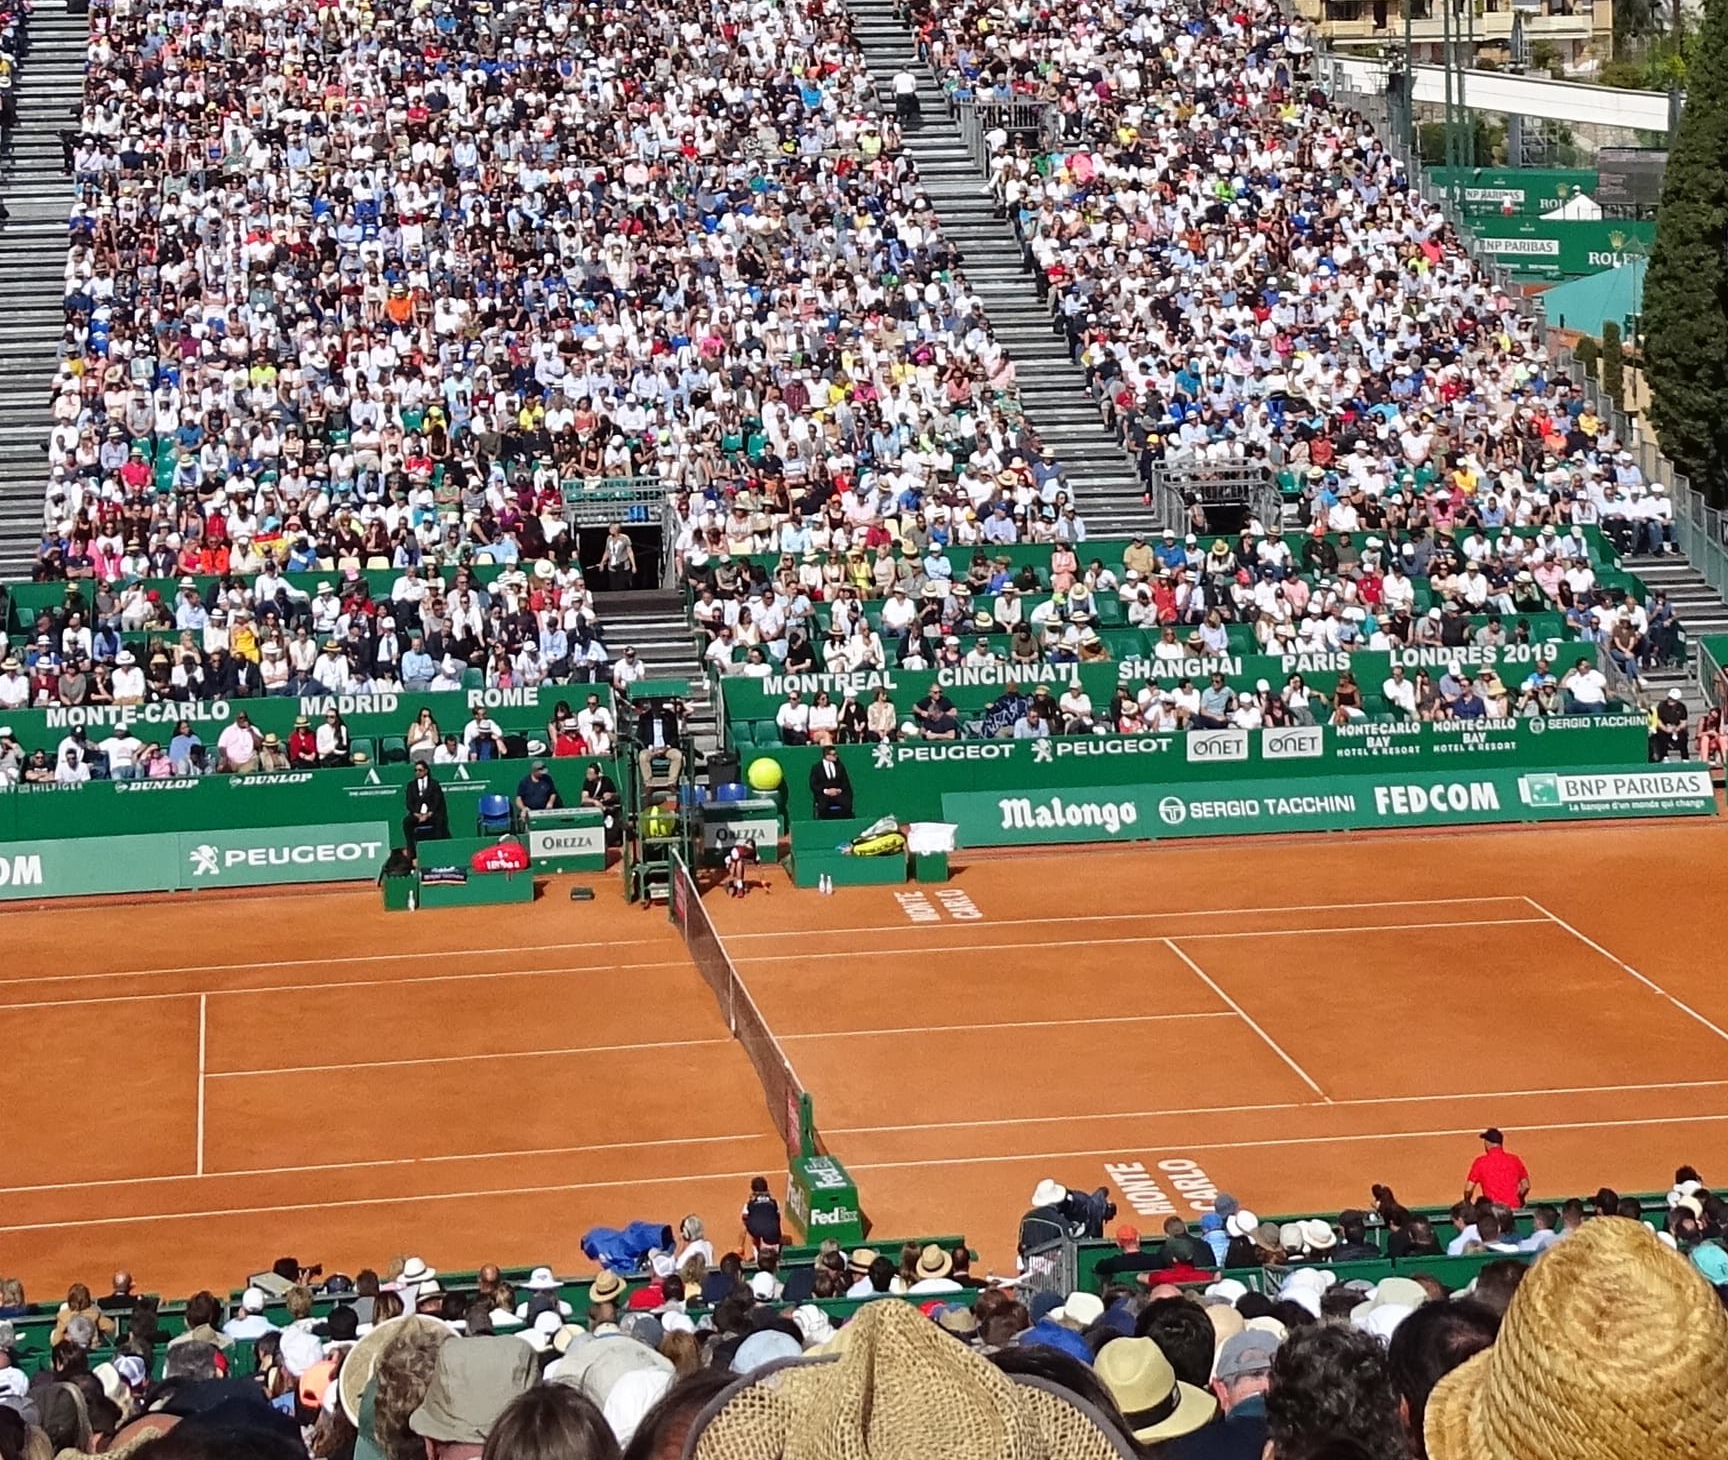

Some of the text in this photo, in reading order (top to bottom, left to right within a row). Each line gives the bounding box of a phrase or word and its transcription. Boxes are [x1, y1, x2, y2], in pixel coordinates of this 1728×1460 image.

[1504, 240, 1553, 252] PARIBAS
[1281, 651, 1351, 673] PARIS
[1390, 643, 1558, 668] LONDRES 2019
[937, 662, 1079, 687] CINCINNATI
[1119, 656, 1243, 679] SHANGHAI
[763, 670, 897, 696] MONTREAL
[300, 693, 398, 716] MADRID
[467, 686, 539, 709] ROME
[46, 700, 230, 728] MONTE-CARLO
[1548, 717, 1591, 730] SERGIO
[1056, 738, 1172, 757] PEUGEOT
[1366, 736, 1390, 748] BAY
[1433, 744, 1465, 753] HOTEL
[1478, 742, 1516, 751] RESORT
[1462, 732, 1487, 744] BAY
[898, 743, 1015, 762] PEUGEOT
[1337, 748, 1369, 757] HOTEL
[1383, 747, 1421, 756] RESORT
[32, 782, 83, 793] HILFIGER
[128, 779, 200, 791] DUNLOP
[242, 773, 313, 786] DUNLOP
[1565, 775, 1701, 797] BNP PARIBAS
[1190, 795, 1356, 819] SERGIO TACCHINI
[1374, 782, 1500, 816] FEDCOM
[1581, 801, 1610, 813] banque
[1611, 800, 1630, 810] d'un
[1631, 799, 1660, 809] monde
[1661, 798, 1674, 810] qui
[1675, 798, 1706, 809] change
[999, 797, 1137, 834] Malongo
[225, 842, 382, 867] PEUGEOT
[1103, 1161, 1178, 1216] MONTE
[1157, 1158, 1219, 1212] CARLO
[810, 1206, 859, 1226] FedEx
